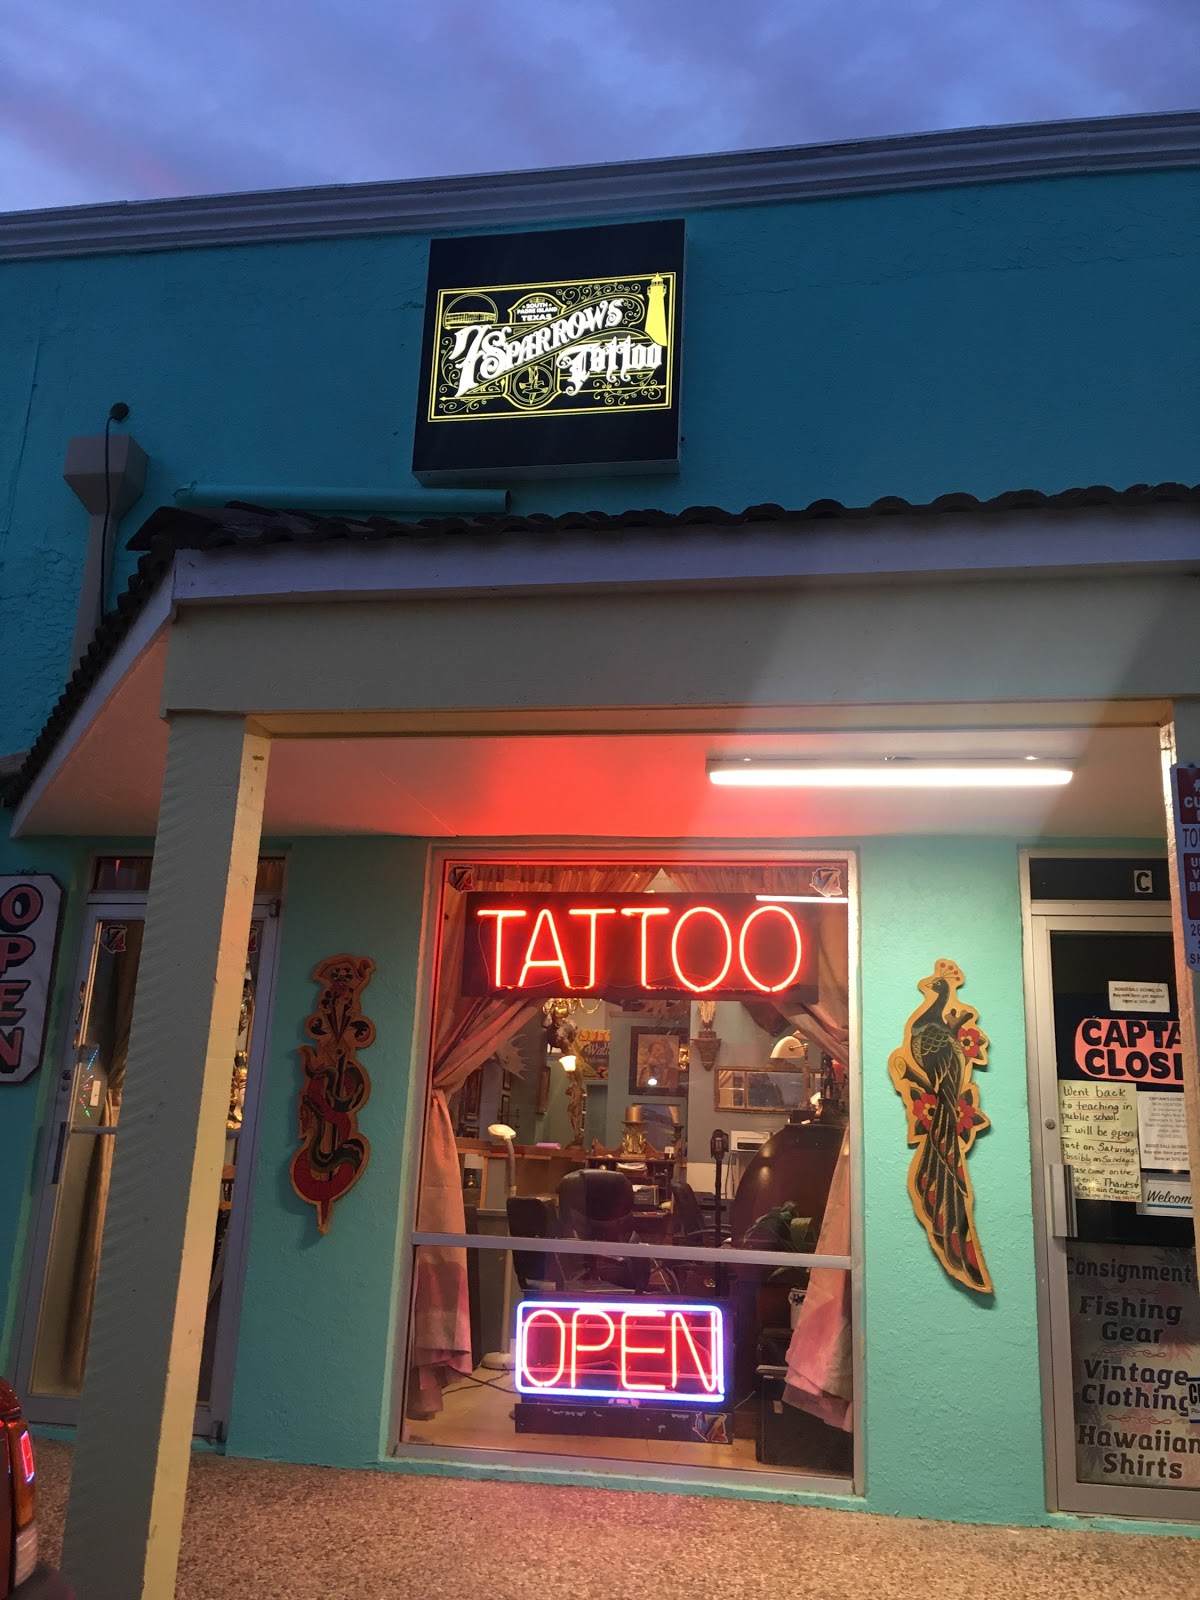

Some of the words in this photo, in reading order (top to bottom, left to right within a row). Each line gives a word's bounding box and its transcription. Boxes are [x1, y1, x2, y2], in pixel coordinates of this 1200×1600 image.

[449, 325, 492, 397] 7
[1136, 871, 1151, 892] C
[477, 904, 802, 993] TATTOO
[1063, 1085, 1090, 1097] Went
[1095, 1085, 1127, 1098] back
[1060, 1100, 1073, 1109] to
[1076, 1100, 1120, 1114] teaching
[1122, 1102, 1133, 1111] in
[1061, 1112, 1090, 1124] public
[1093, 1112, 1120, 1121] school.
[1063, 1124, 1072, 1133] I
[1075, 1125, 1093, 1136] will
[1097, 1124, 1108, 1137] be
[1111, 1129, 1134, 1140] open
[1119, 1168, 1135, 1176] the
[1067, 1256, 1191, 1283] Consignment
[1079, 1295, 1183, 1326] Fishing
[1101, 1321, 1163, 1343] Gear
[522, 1309, 718, 1392] OPEN
[1084, 1359, 1188, 1389] Vintage
[1081, 1383, 1189, 1417] Clothing
[1078, 1424, 1200, 1454] Hawaiian
[1103, 1452, 1183, 1479] Shirts
